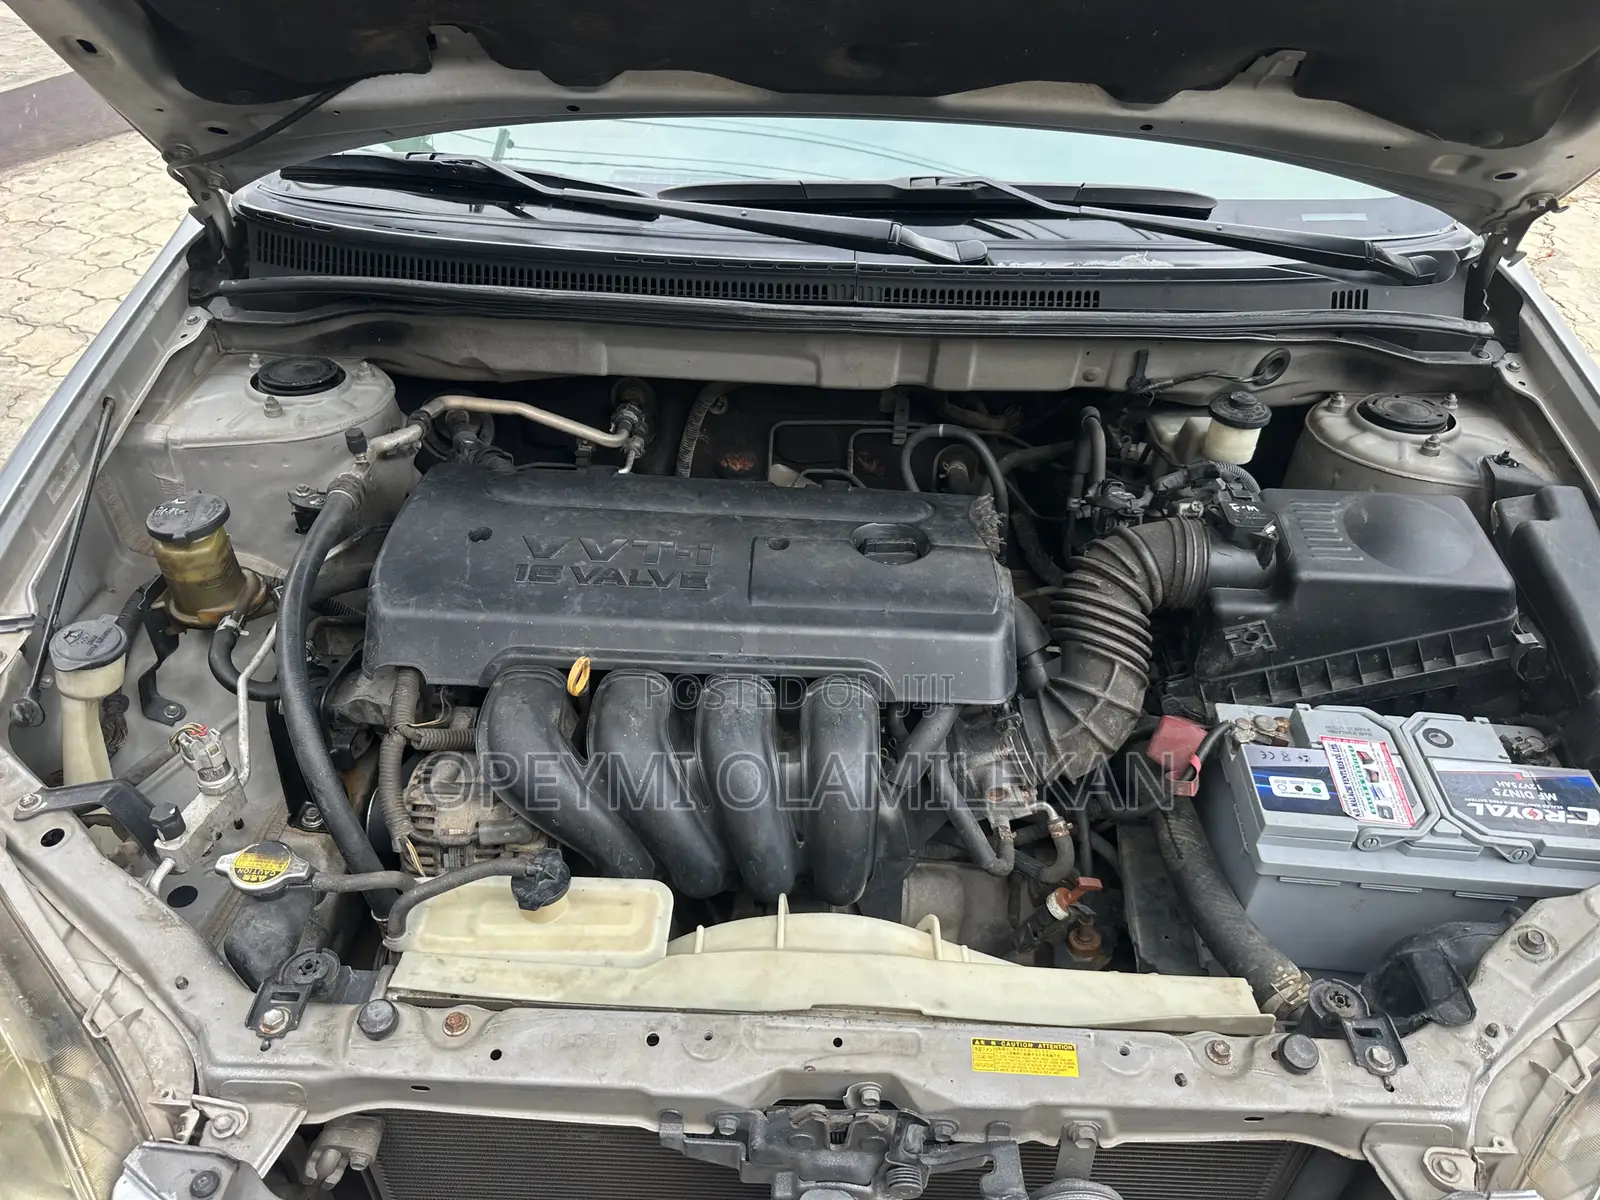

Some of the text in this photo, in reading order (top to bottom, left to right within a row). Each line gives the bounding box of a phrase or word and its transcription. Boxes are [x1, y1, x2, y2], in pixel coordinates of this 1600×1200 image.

[569, 565, 710, 591] VALVE
[1492, 787, 1534, 799] DIN75
[238, 867, 275, 876] CAUTION
[1038, 1043, 1073, 1051] ATTENTION
